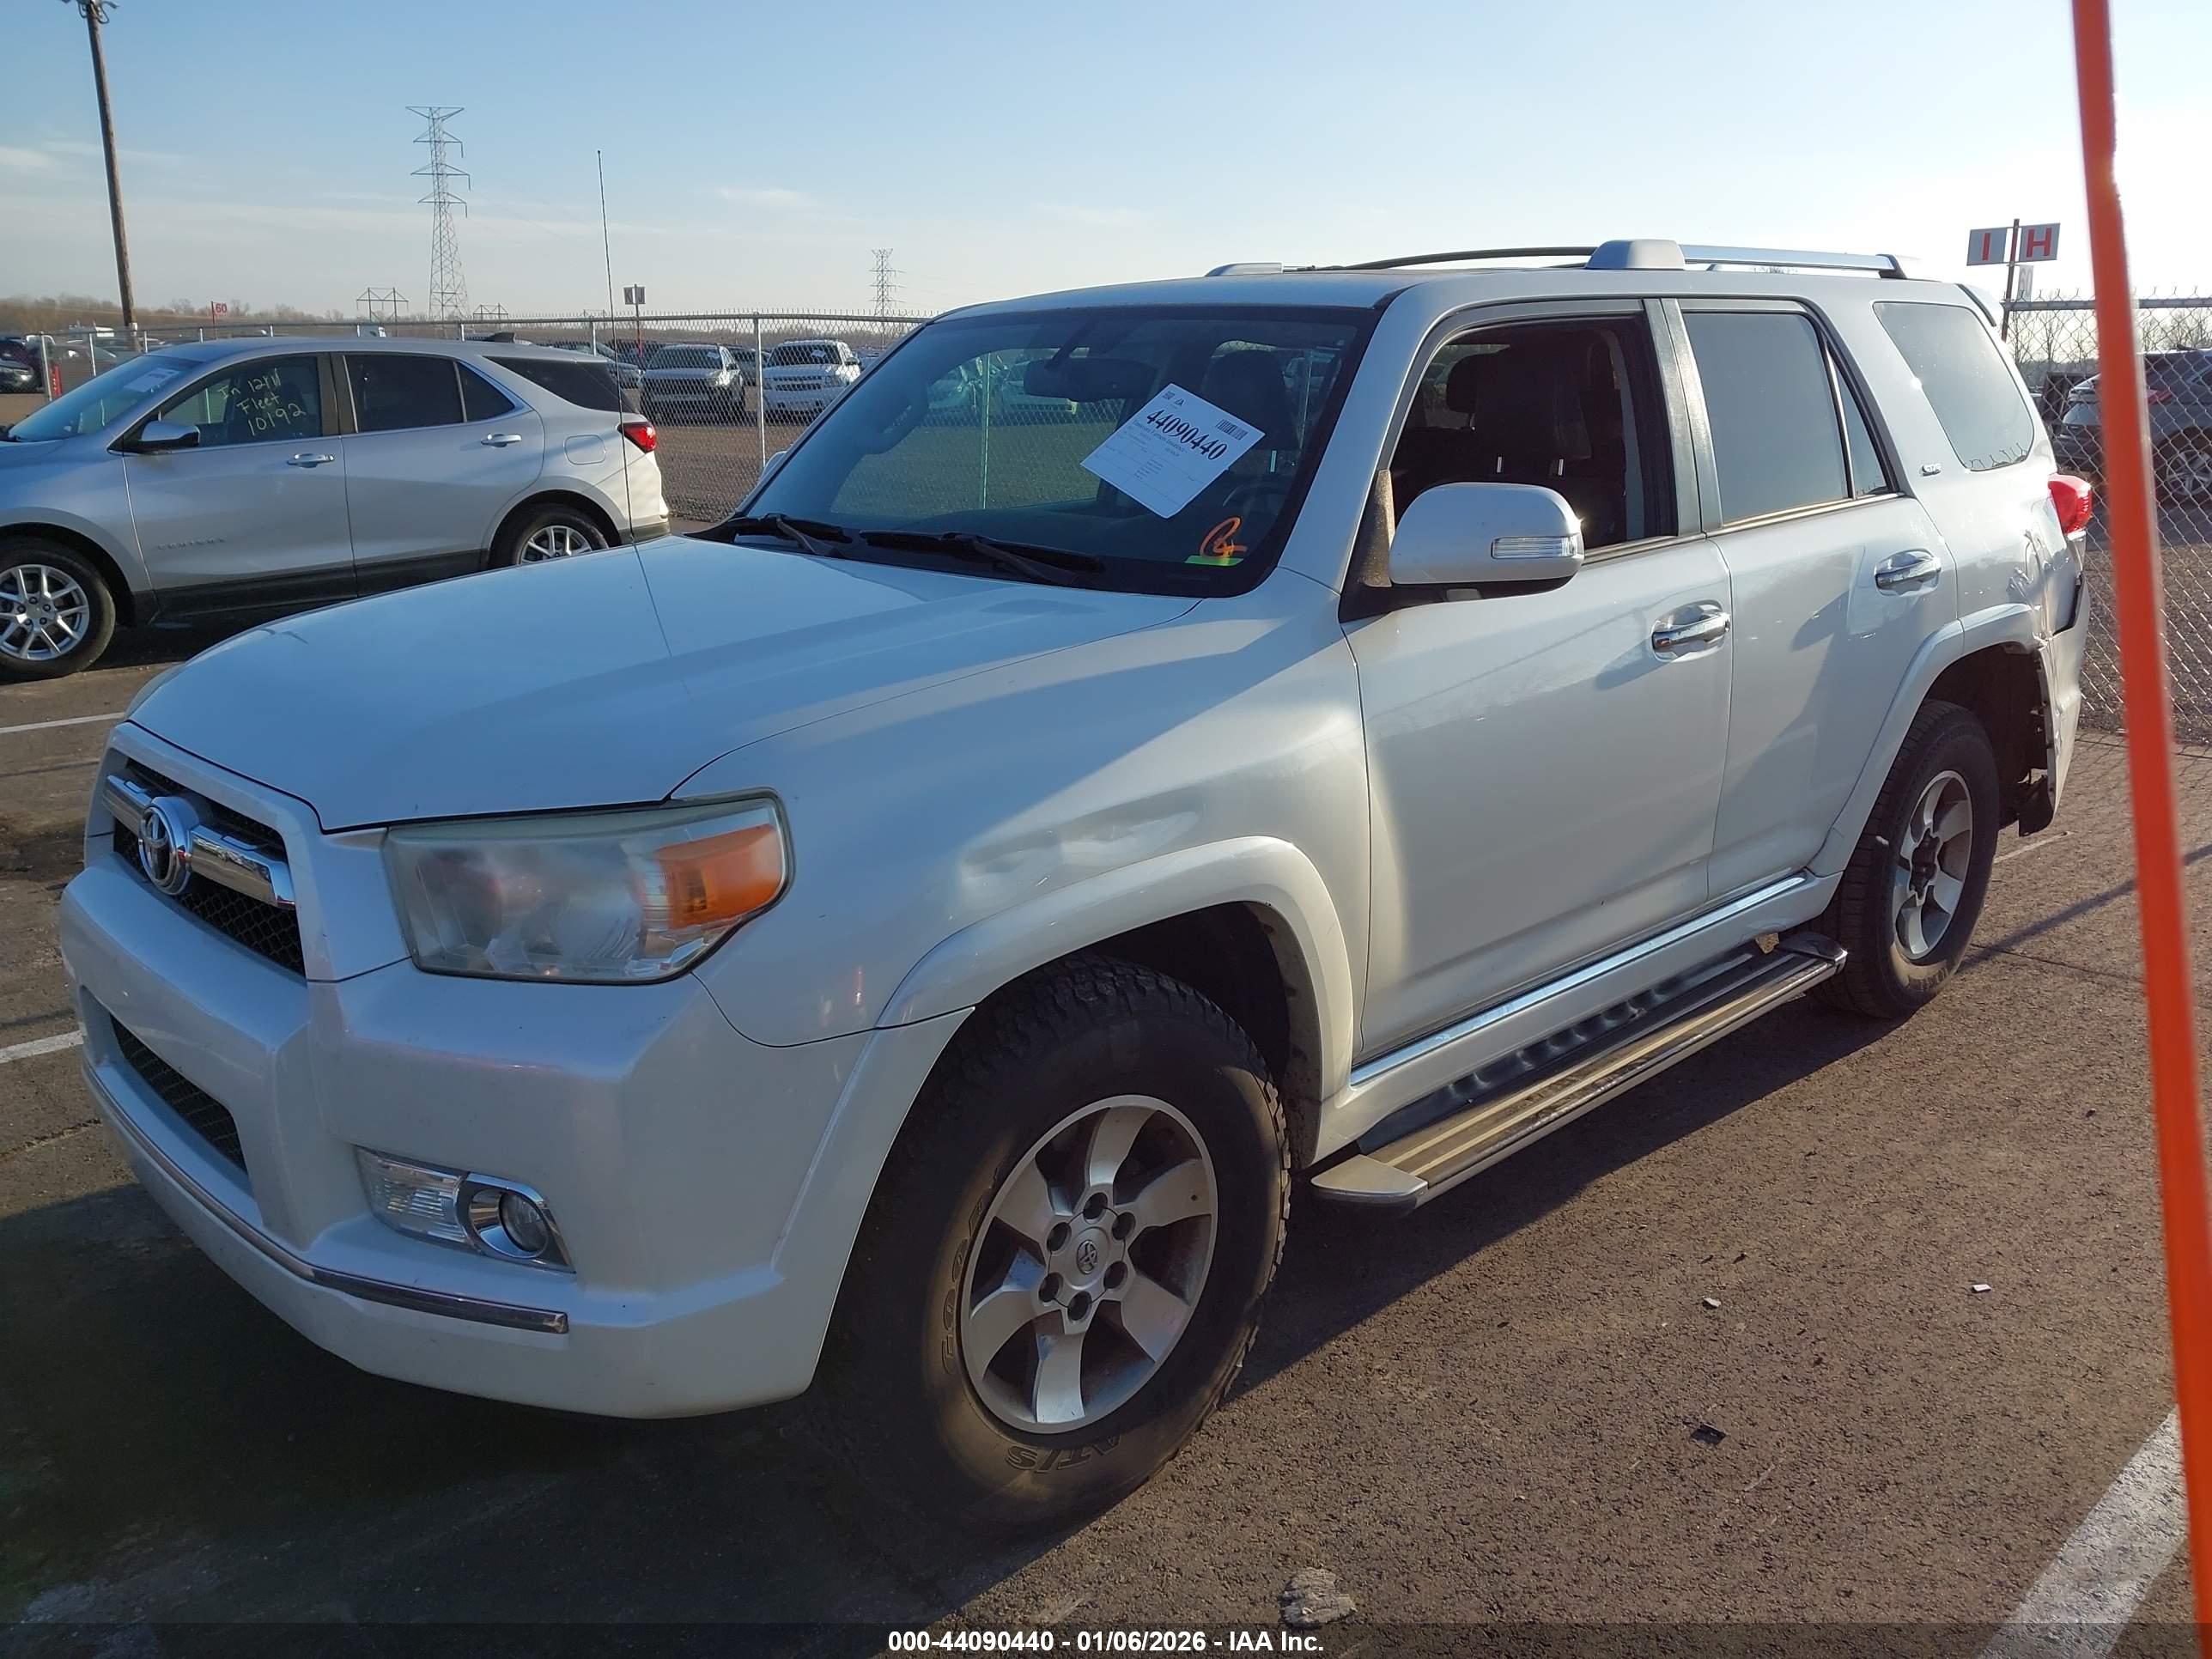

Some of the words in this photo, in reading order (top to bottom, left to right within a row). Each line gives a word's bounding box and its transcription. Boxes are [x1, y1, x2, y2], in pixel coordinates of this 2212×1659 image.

[2026, 228, 2052, 258] H
[216, 303, 228, 313] 60
[217, 385, 241, 399] In
[236, 392, 280, 415] Fleet
[247, 404, 307, 436] 10192
[1146, 410, 1228, 460] 44090440
